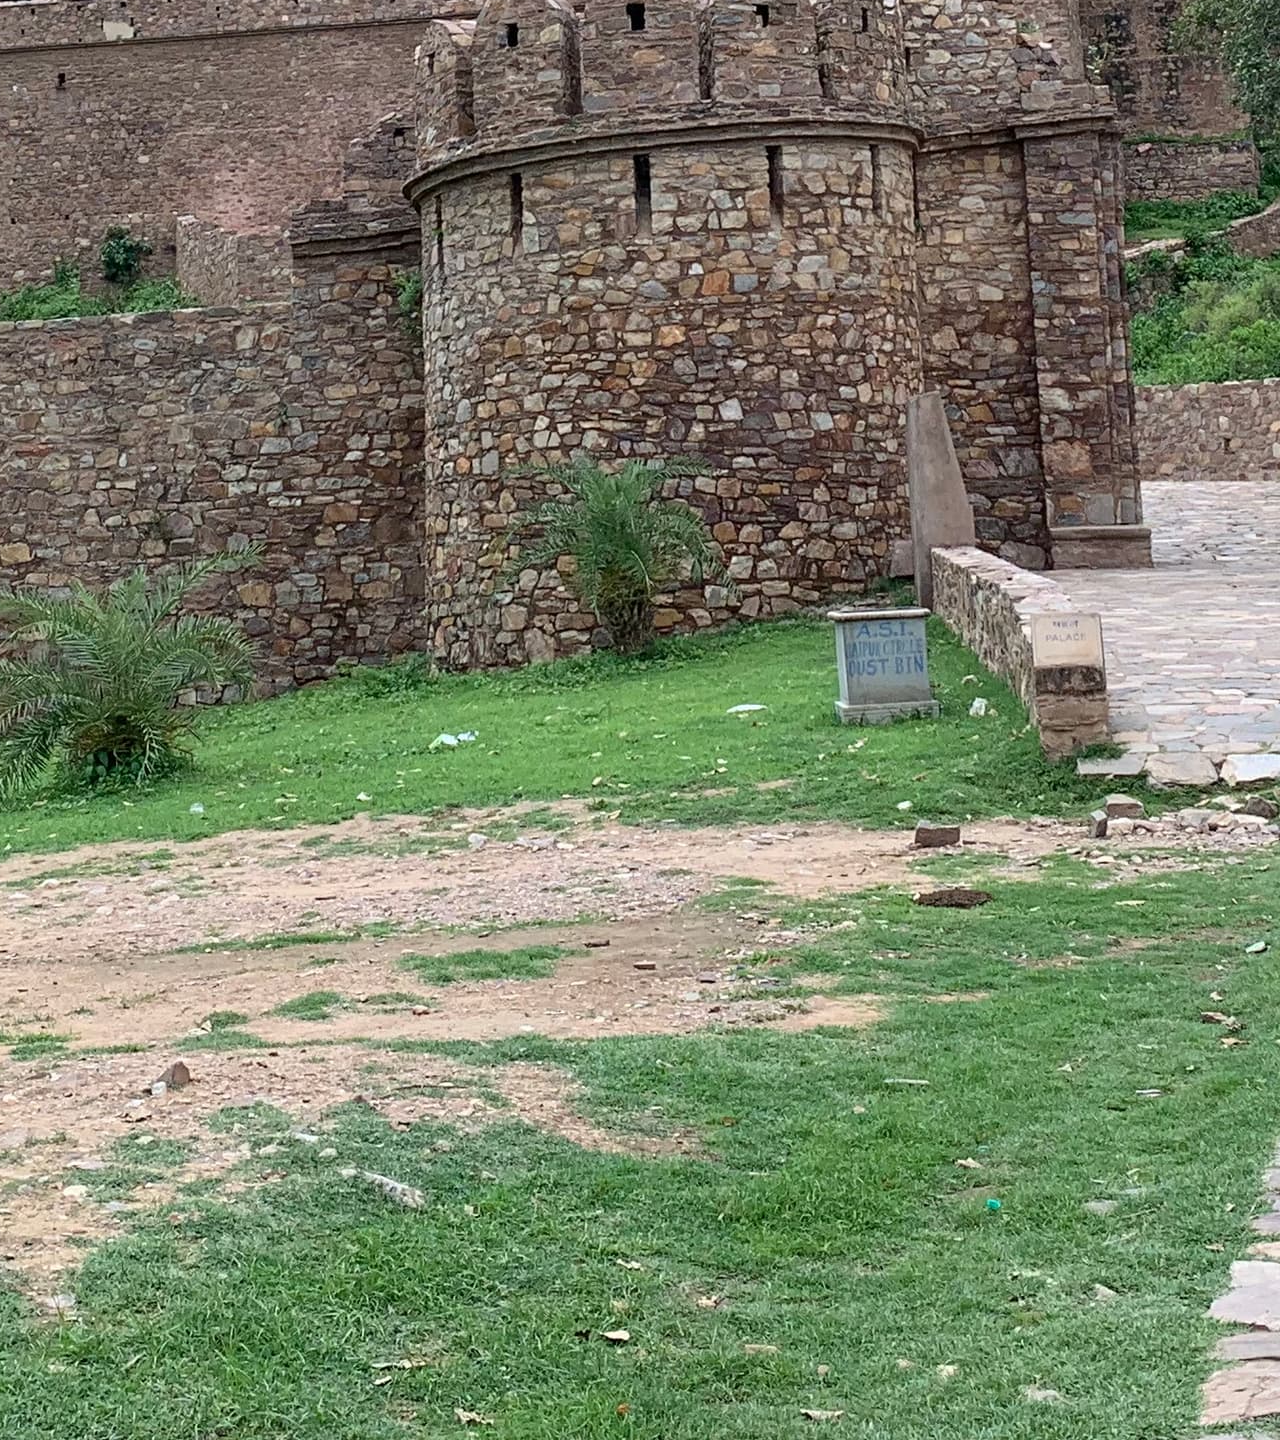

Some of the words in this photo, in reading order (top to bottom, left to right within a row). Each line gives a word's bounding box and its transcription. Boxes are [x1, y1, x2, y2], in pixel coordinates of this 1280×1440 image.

[856, 621, 914, 638] A.S.I.
[848, 658, 889, 677] DUST
[895, 655, 924, 674] BIN
